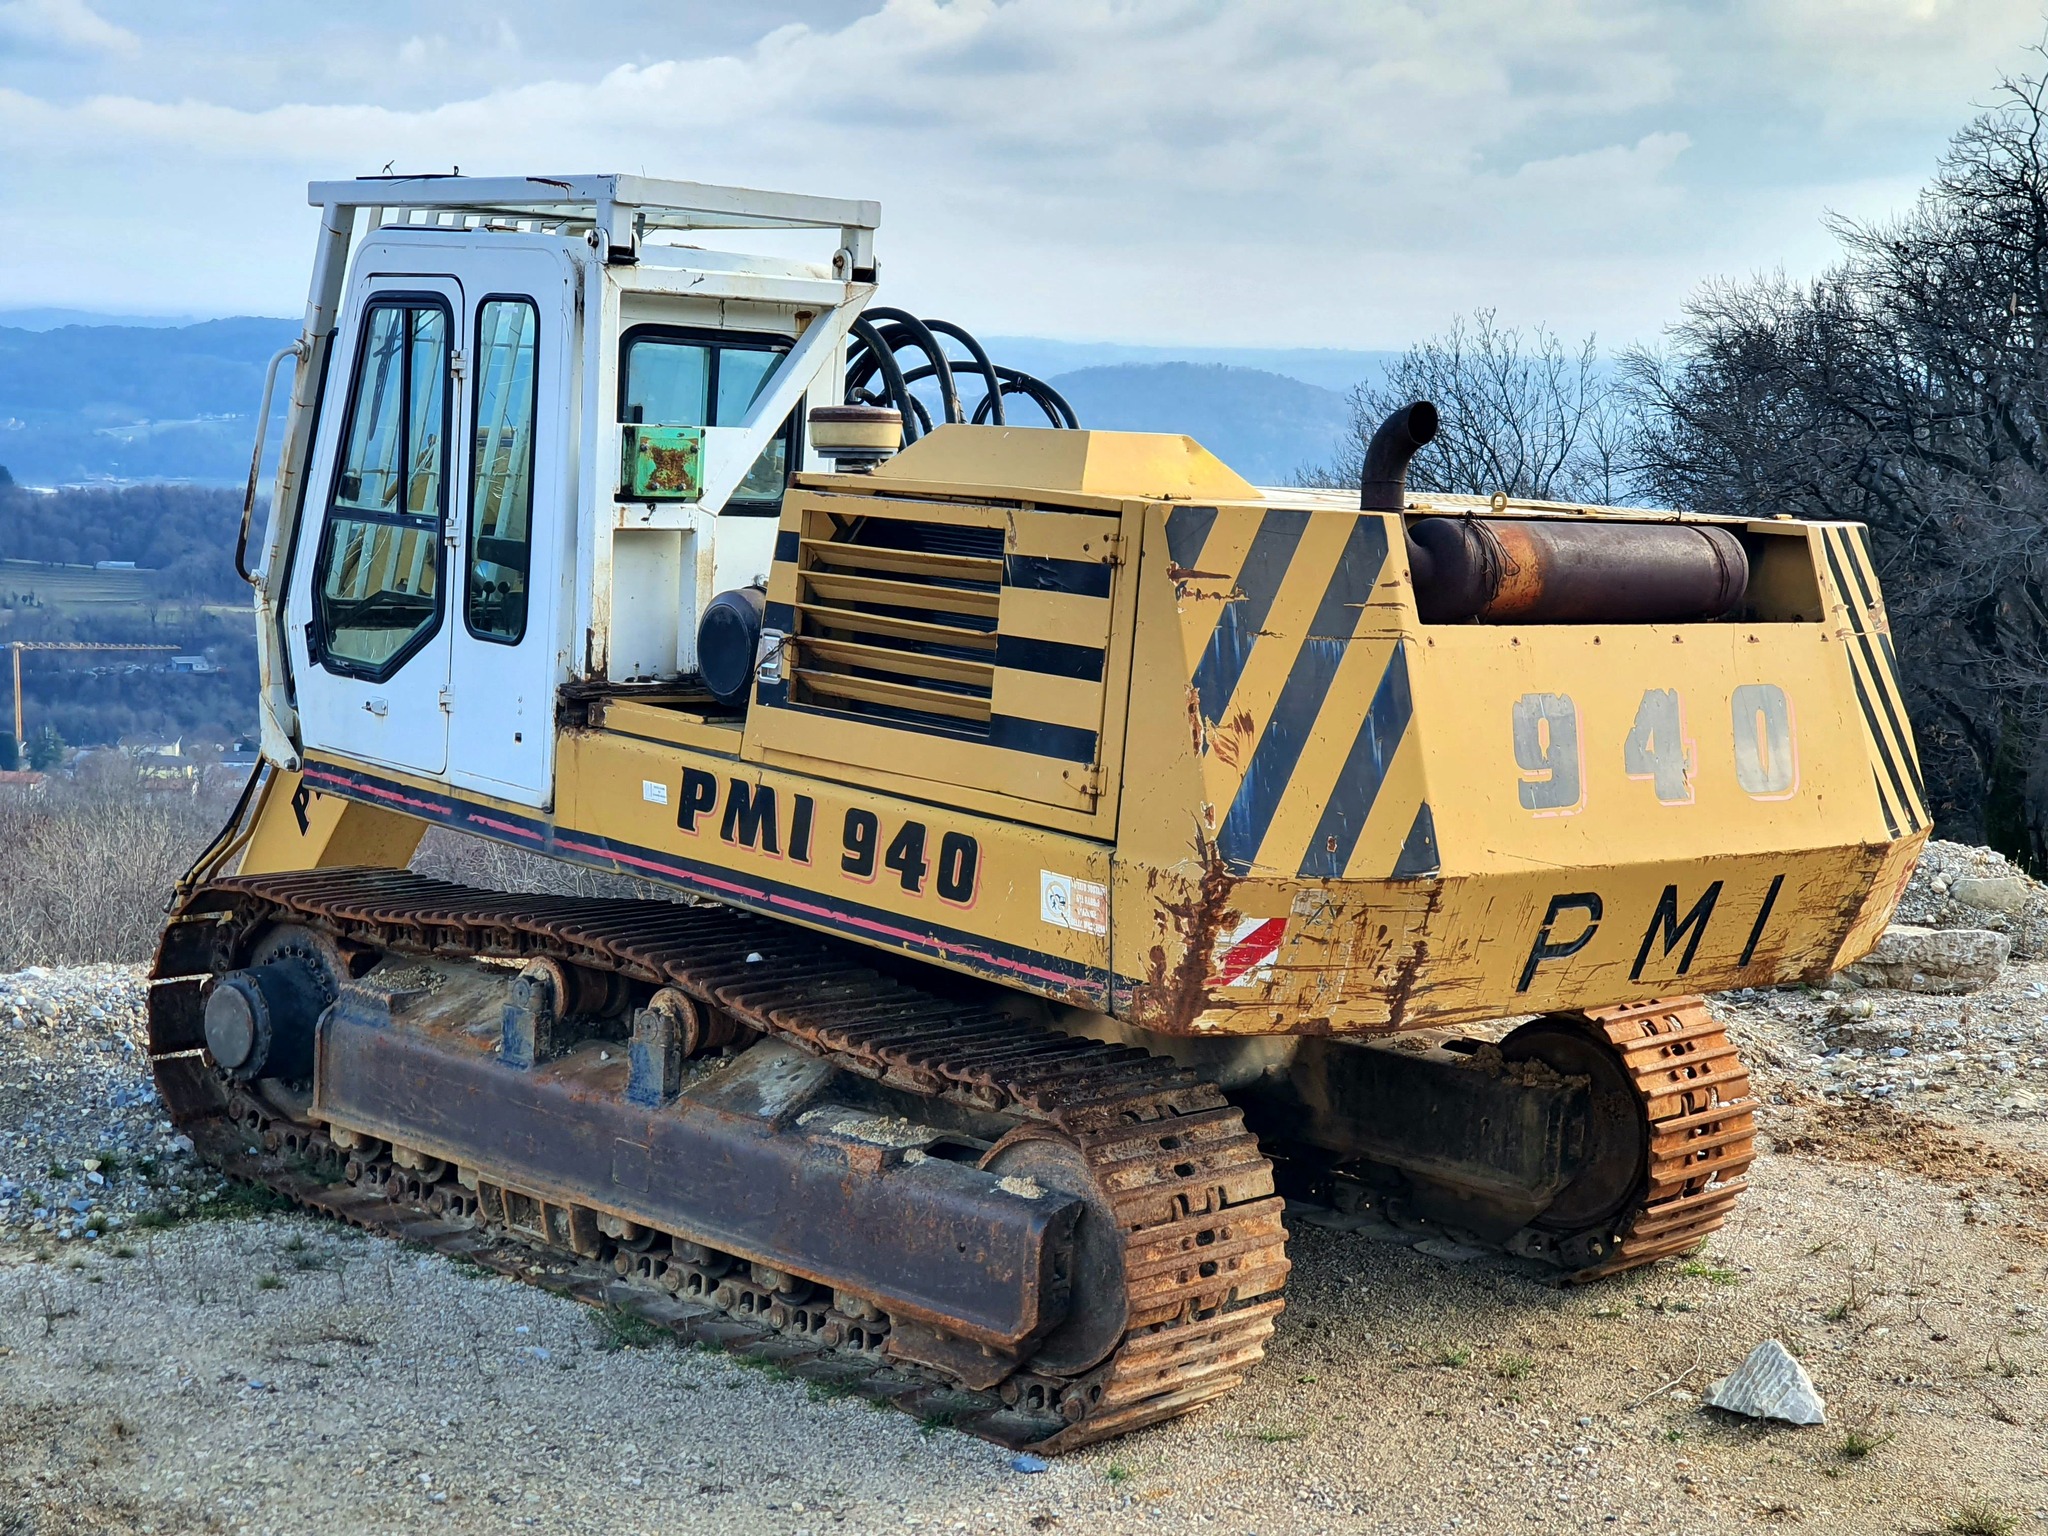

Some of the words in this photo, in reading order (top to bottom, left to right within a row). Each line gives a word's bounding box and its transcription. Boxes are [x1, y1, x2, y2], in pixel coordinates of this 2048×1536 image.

[1512, 683, 1799, 817] 940
[677, 766, 816, 866] PMI
[841, 807, 983, 910] 940
[1516, 873, 1786, 993] PMI
